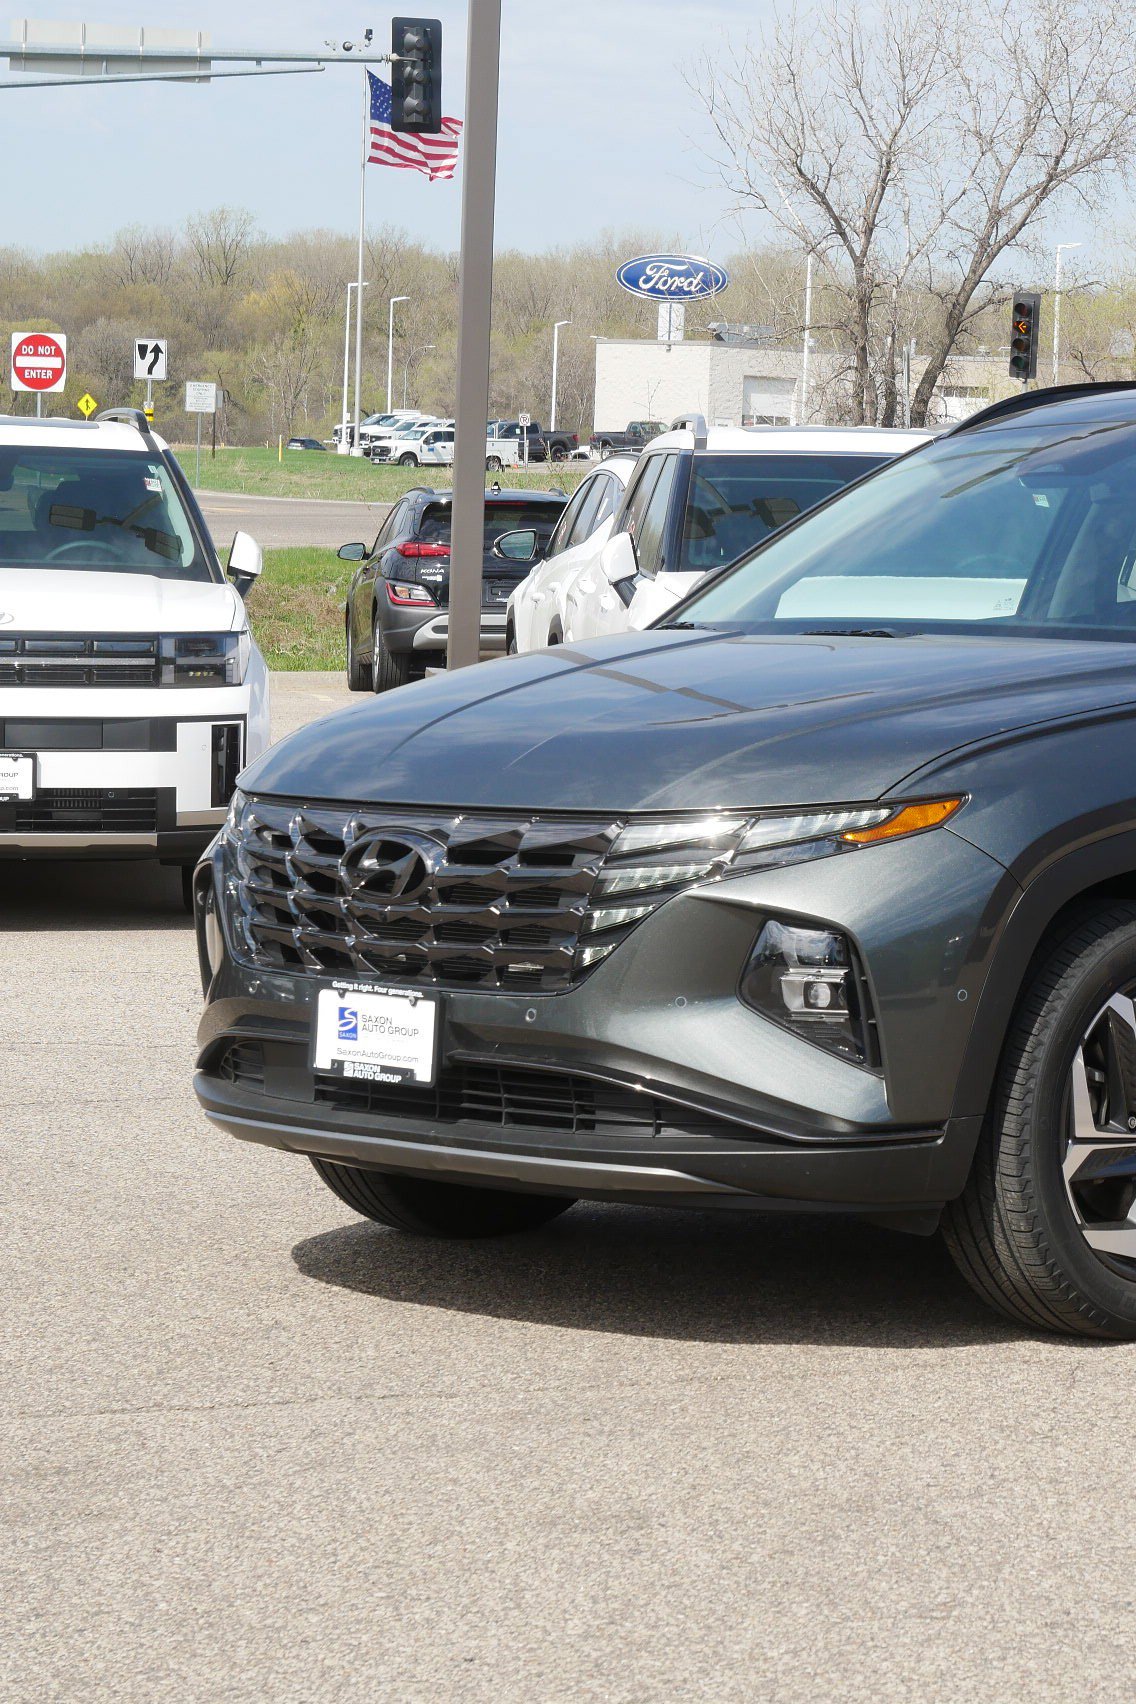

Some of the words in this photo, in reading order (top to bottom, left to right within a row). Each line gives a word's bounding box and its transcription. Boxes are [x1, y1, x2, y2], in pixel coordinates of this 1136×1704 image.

[638, 262, 704, 292] Ford
[21, 345, 34, 355] DO
[38, 345, 56, 356] NOT
[24, 369, 53, 379] ENTER
[374, 985, 388, 994] Four
[361, 1014, 393, 1026] SAXON
[339, 1031, 357, 1039] SAXON
[361, 1023, 386, 1034] AUTO
[387, 1026, 419, 1037] GROUP
[336, 1047, 419, 1063] SaxonAutoGroup.com
[354, 1062, 381, 1072] SAXON
[353, 1070, 375, 1080] AUTO
[374, 1072, 402, 1083] GROUP
